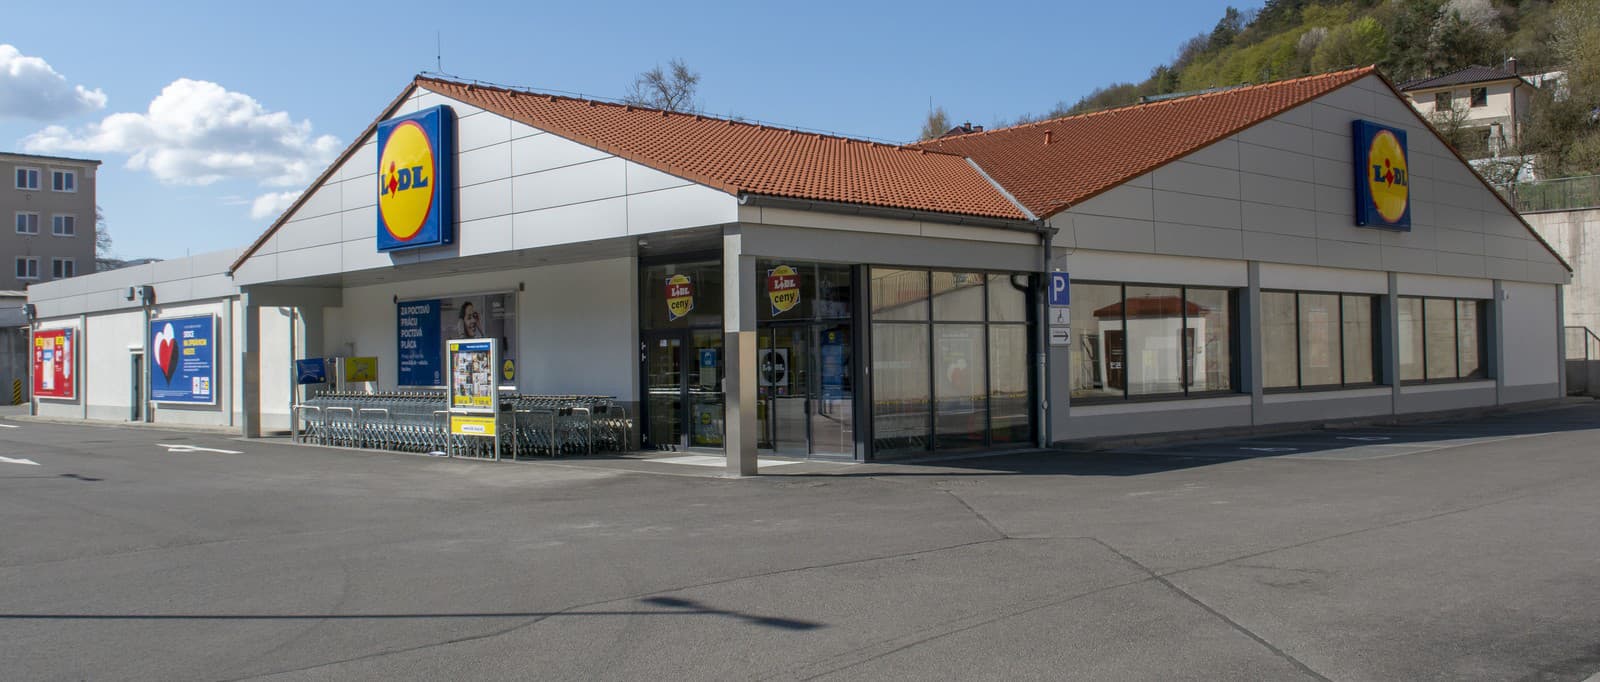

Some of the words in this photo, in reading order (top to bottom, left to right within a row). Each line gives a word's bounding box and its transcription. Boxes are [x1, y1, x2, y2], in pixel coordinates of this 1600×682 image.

[1053, 276, 1065, 302] P
[774, 292, 795, 303] ceny
[671, 299, 689, 309] ceny
